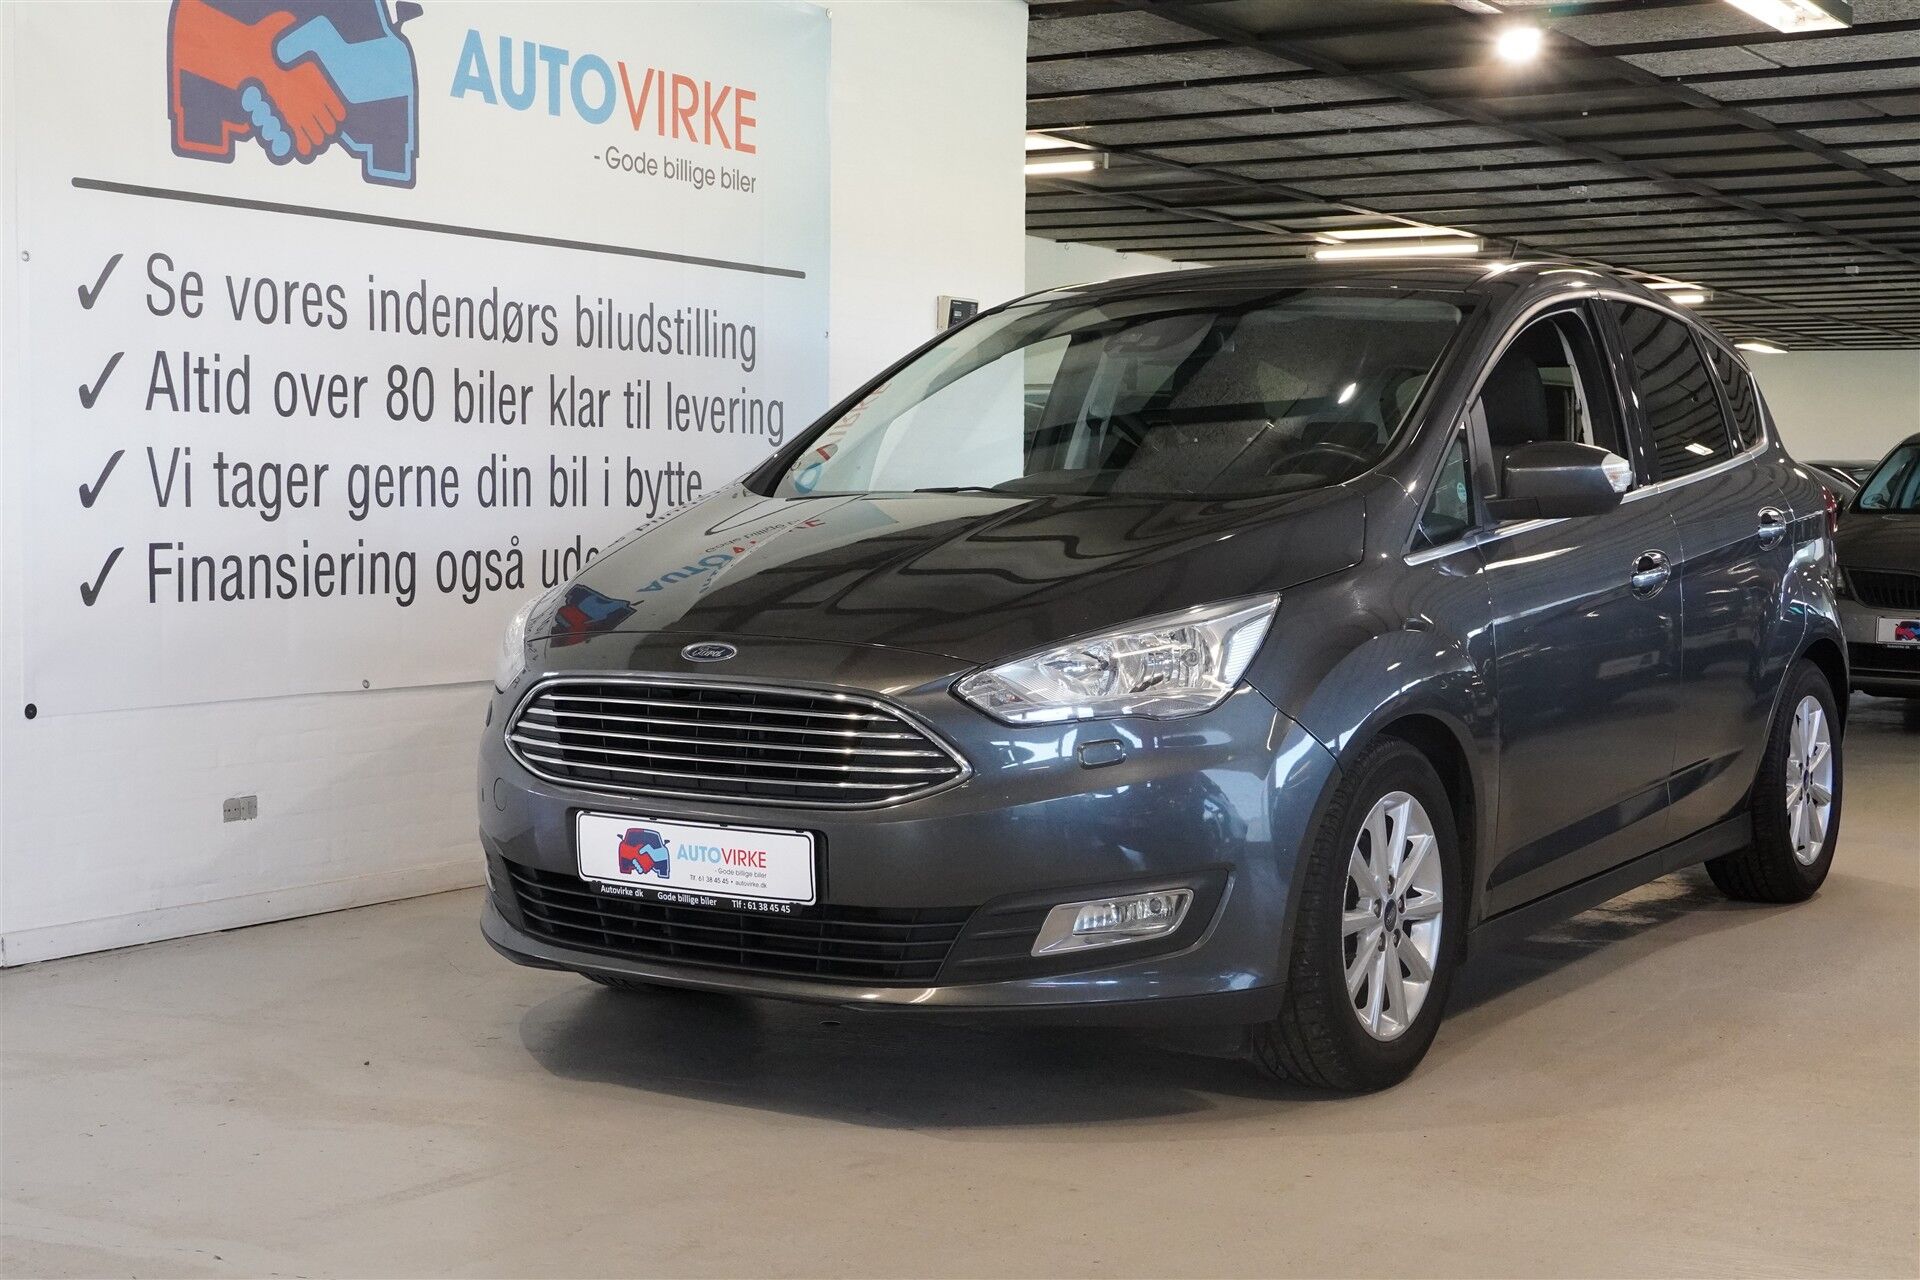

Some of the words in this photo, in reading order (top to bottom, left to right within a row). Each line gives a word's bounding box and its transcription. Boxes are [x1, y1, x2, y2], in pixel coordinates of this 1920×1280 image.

[451, 28, 757, 155] AUTOVIRKE
[605, 145, 658, 178] Gode
[663, 155, 716, 191] billige
[720, 166, 757, 195] biler
[145, 251, 204, 318] Se
[225, 275, 348, 330] vores
[368, 274, 559, 347] indendørs
[575, 294, 758, 372] biludstilling
[145, 350, 250, 416] Altid
[273, 371, 369, 419] over
[386, 364, 435, 423] 80
[454, 367, 534, 426] biler
[549, 373, 611, 428] klar
[623, 379, 651, 430] til
[666, 381, 785, 446] levering
[146, 446, 192, 508] Vi
[212, 451, 330, 523] tager
[347, 463, 459, 522] gerne
[477, 453, 532, 509] din
[549, 455, 587, 508] bil
[604, 456, 609, 507] i
[626, 455, 703, 518] bytte
[147, 540, 417, 607] Finansiering
[435, 534, 525, 609] også
[676, 843, 767, 869] AUTOVIRKE
[717, 867, 735, 876] Gode
[600, 884, 633, 896] Autovirke
[657, 891, 677, 902] Gode
[677, 894, 699, 906] billige
[700, 896, 718, 906] biler
[747, 901, 757, 911] 61
[758, 902, 769, 912] 38
[769, 903, 780, 913] 45
[780, 904, 792, 914] 45
